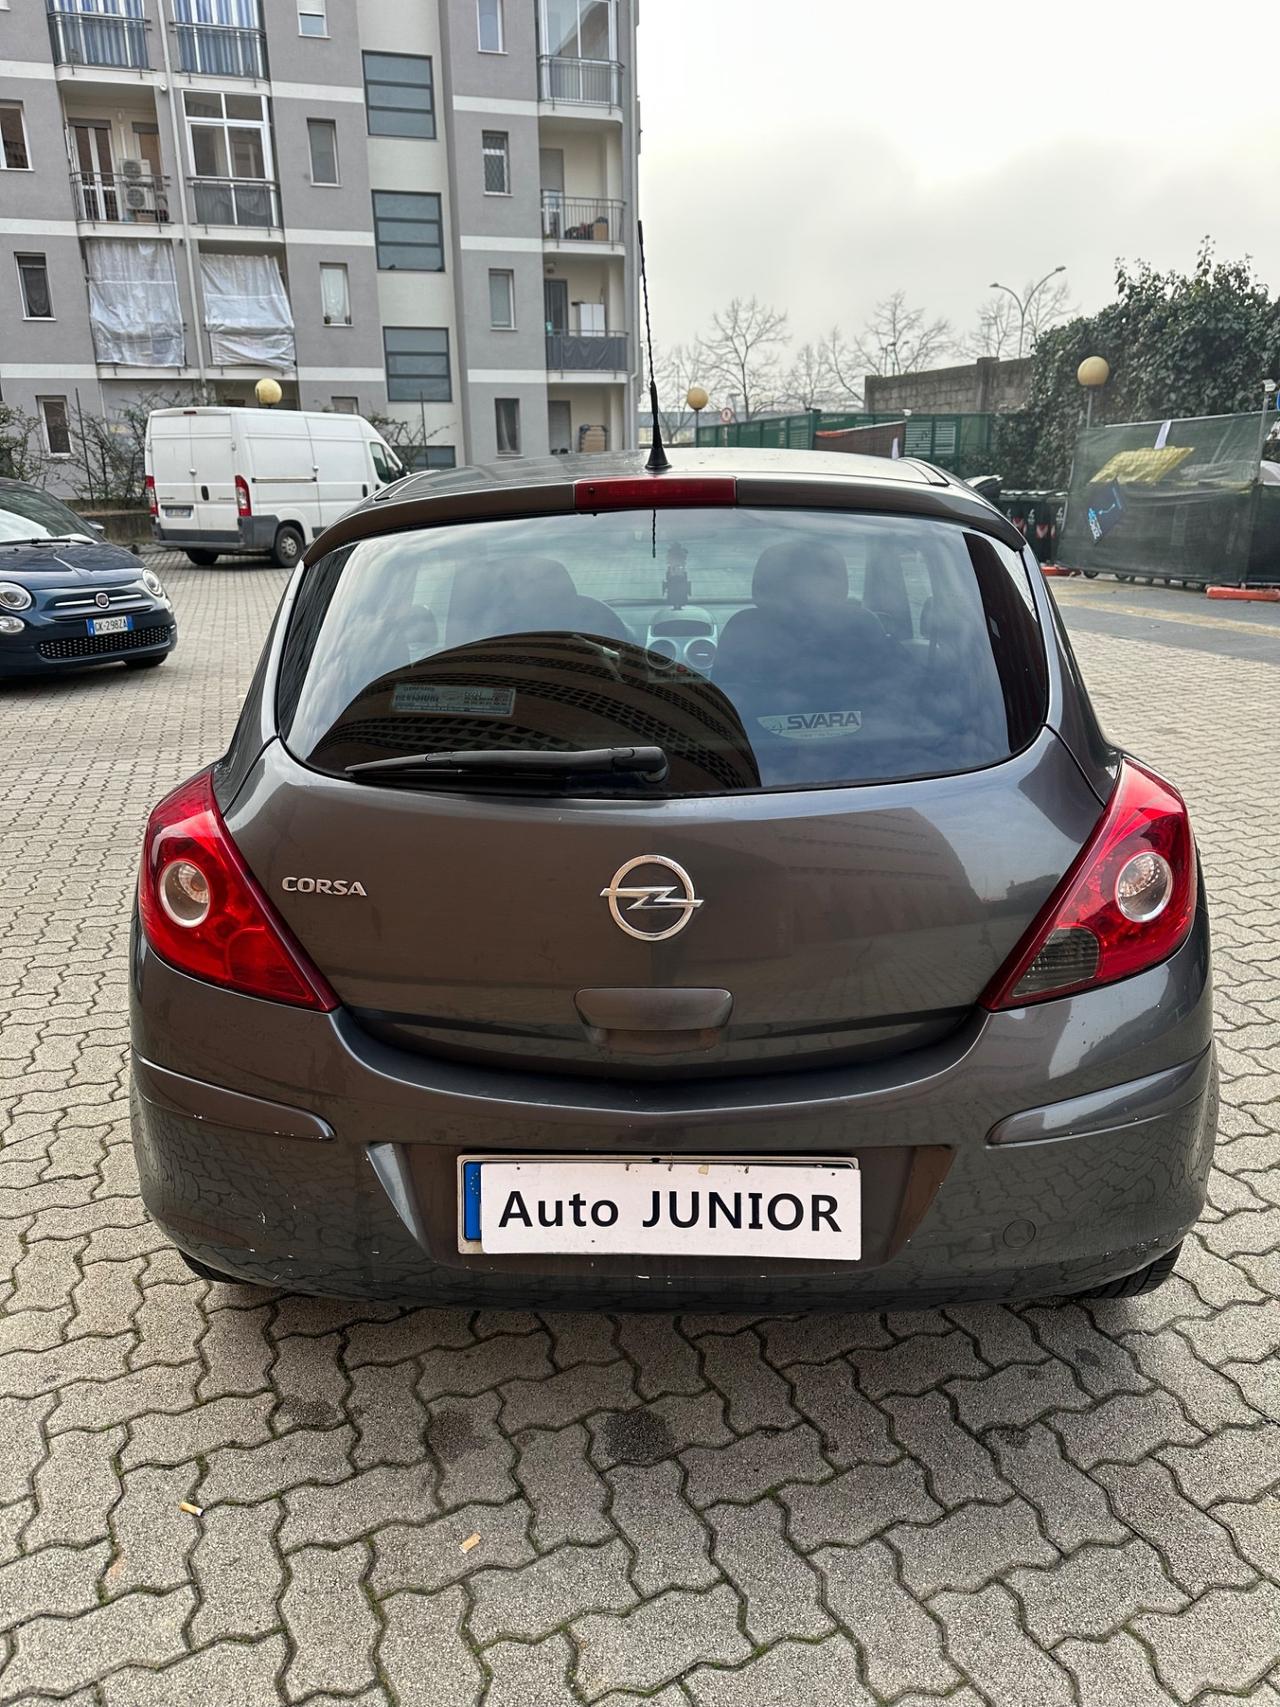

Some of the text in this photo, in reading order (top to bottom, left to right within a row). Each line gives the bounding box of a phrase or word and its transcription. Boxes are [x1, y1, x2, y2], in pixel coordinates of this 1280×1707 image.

[787, 711, 860, 729] SVARA
[282, 875, 367, 896] CORSA
[498, 1189, 842, 1233] Auto JUNIOR
